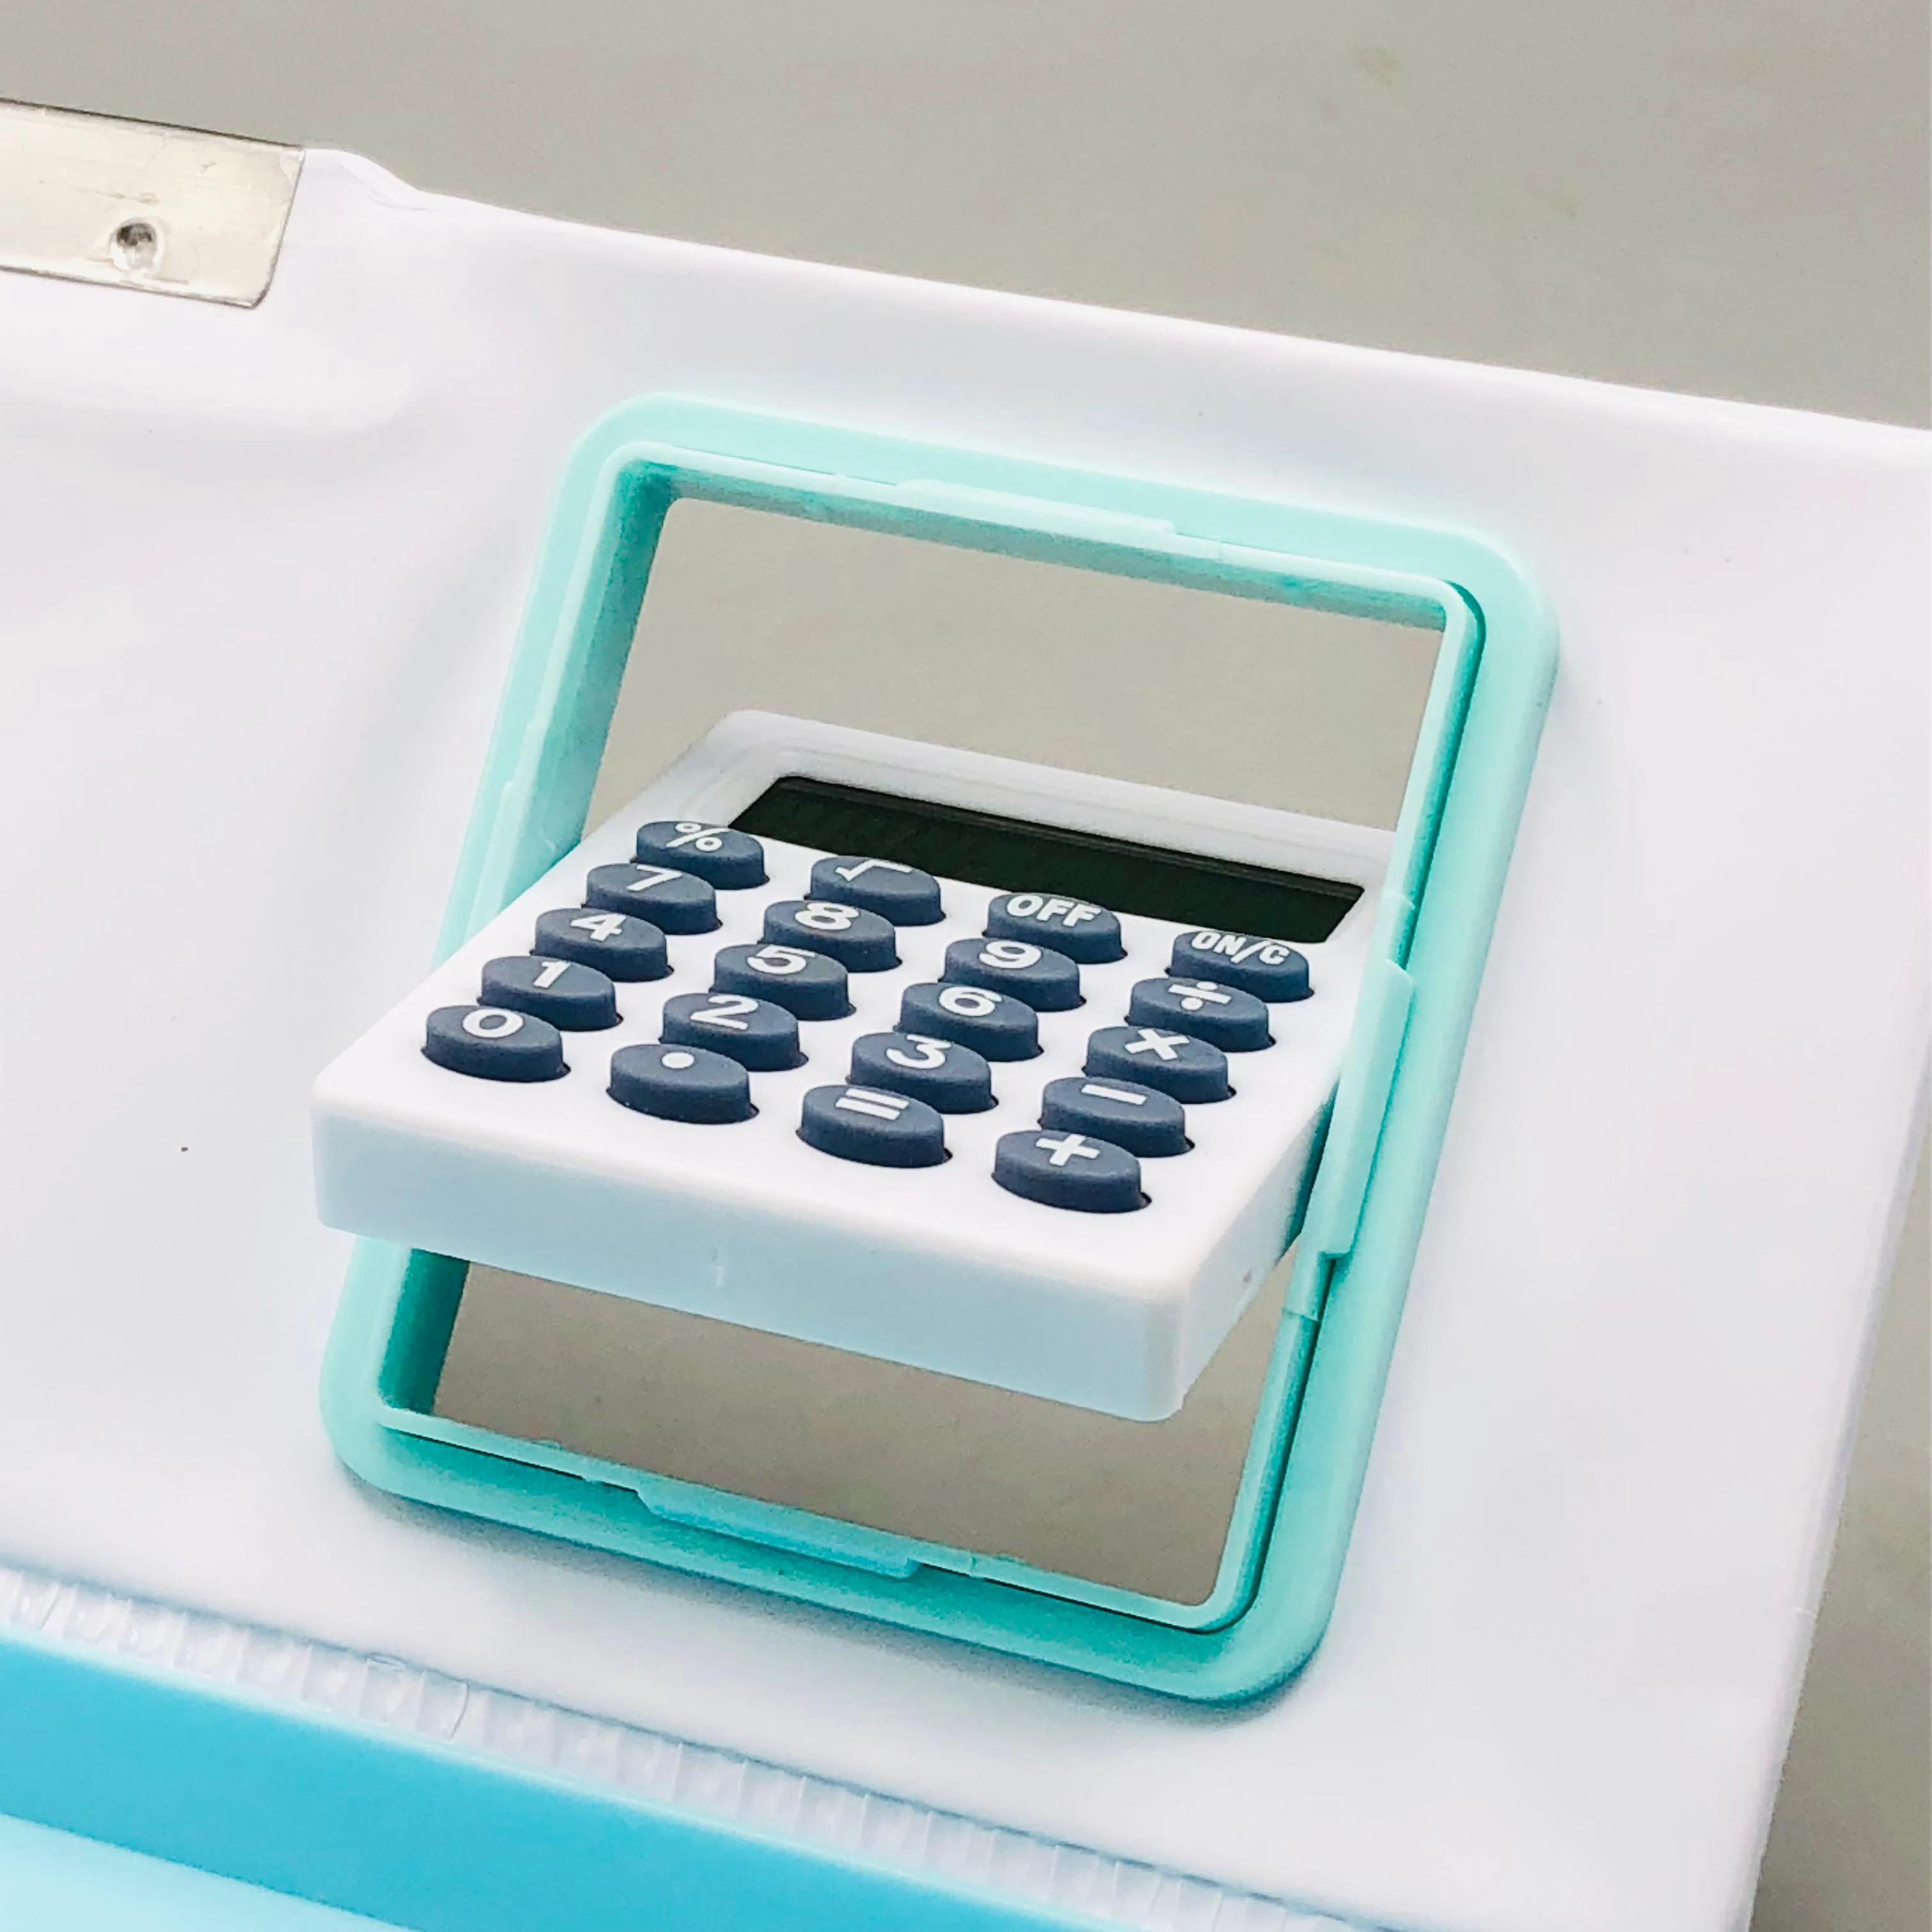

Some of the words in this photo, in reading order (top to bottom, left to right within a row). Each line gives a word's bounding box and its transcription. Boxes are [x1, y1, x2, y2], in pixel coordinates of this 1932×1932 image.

[665, 822, 732, 852] %
[626, 864, 683, 893] 7
[794, 902, 860, 931] 8
[1006, 894, 1101, 928] OFF
[571, 912, 627, 942] 4
[746, 945, 818, 976] 5
[978, 939, 1042, 969] 9
[1190, 931, 1289, 966] ON/C
[533, 960, 572, 989] 1
[690, 994, 759, 1031] 2
[938, 986, 1003, 1018] 6
[885, 1034, 952, 1070] 3
[834, 1087, 909, 1120] =
[1035, 1133, 1100, 1166] +
